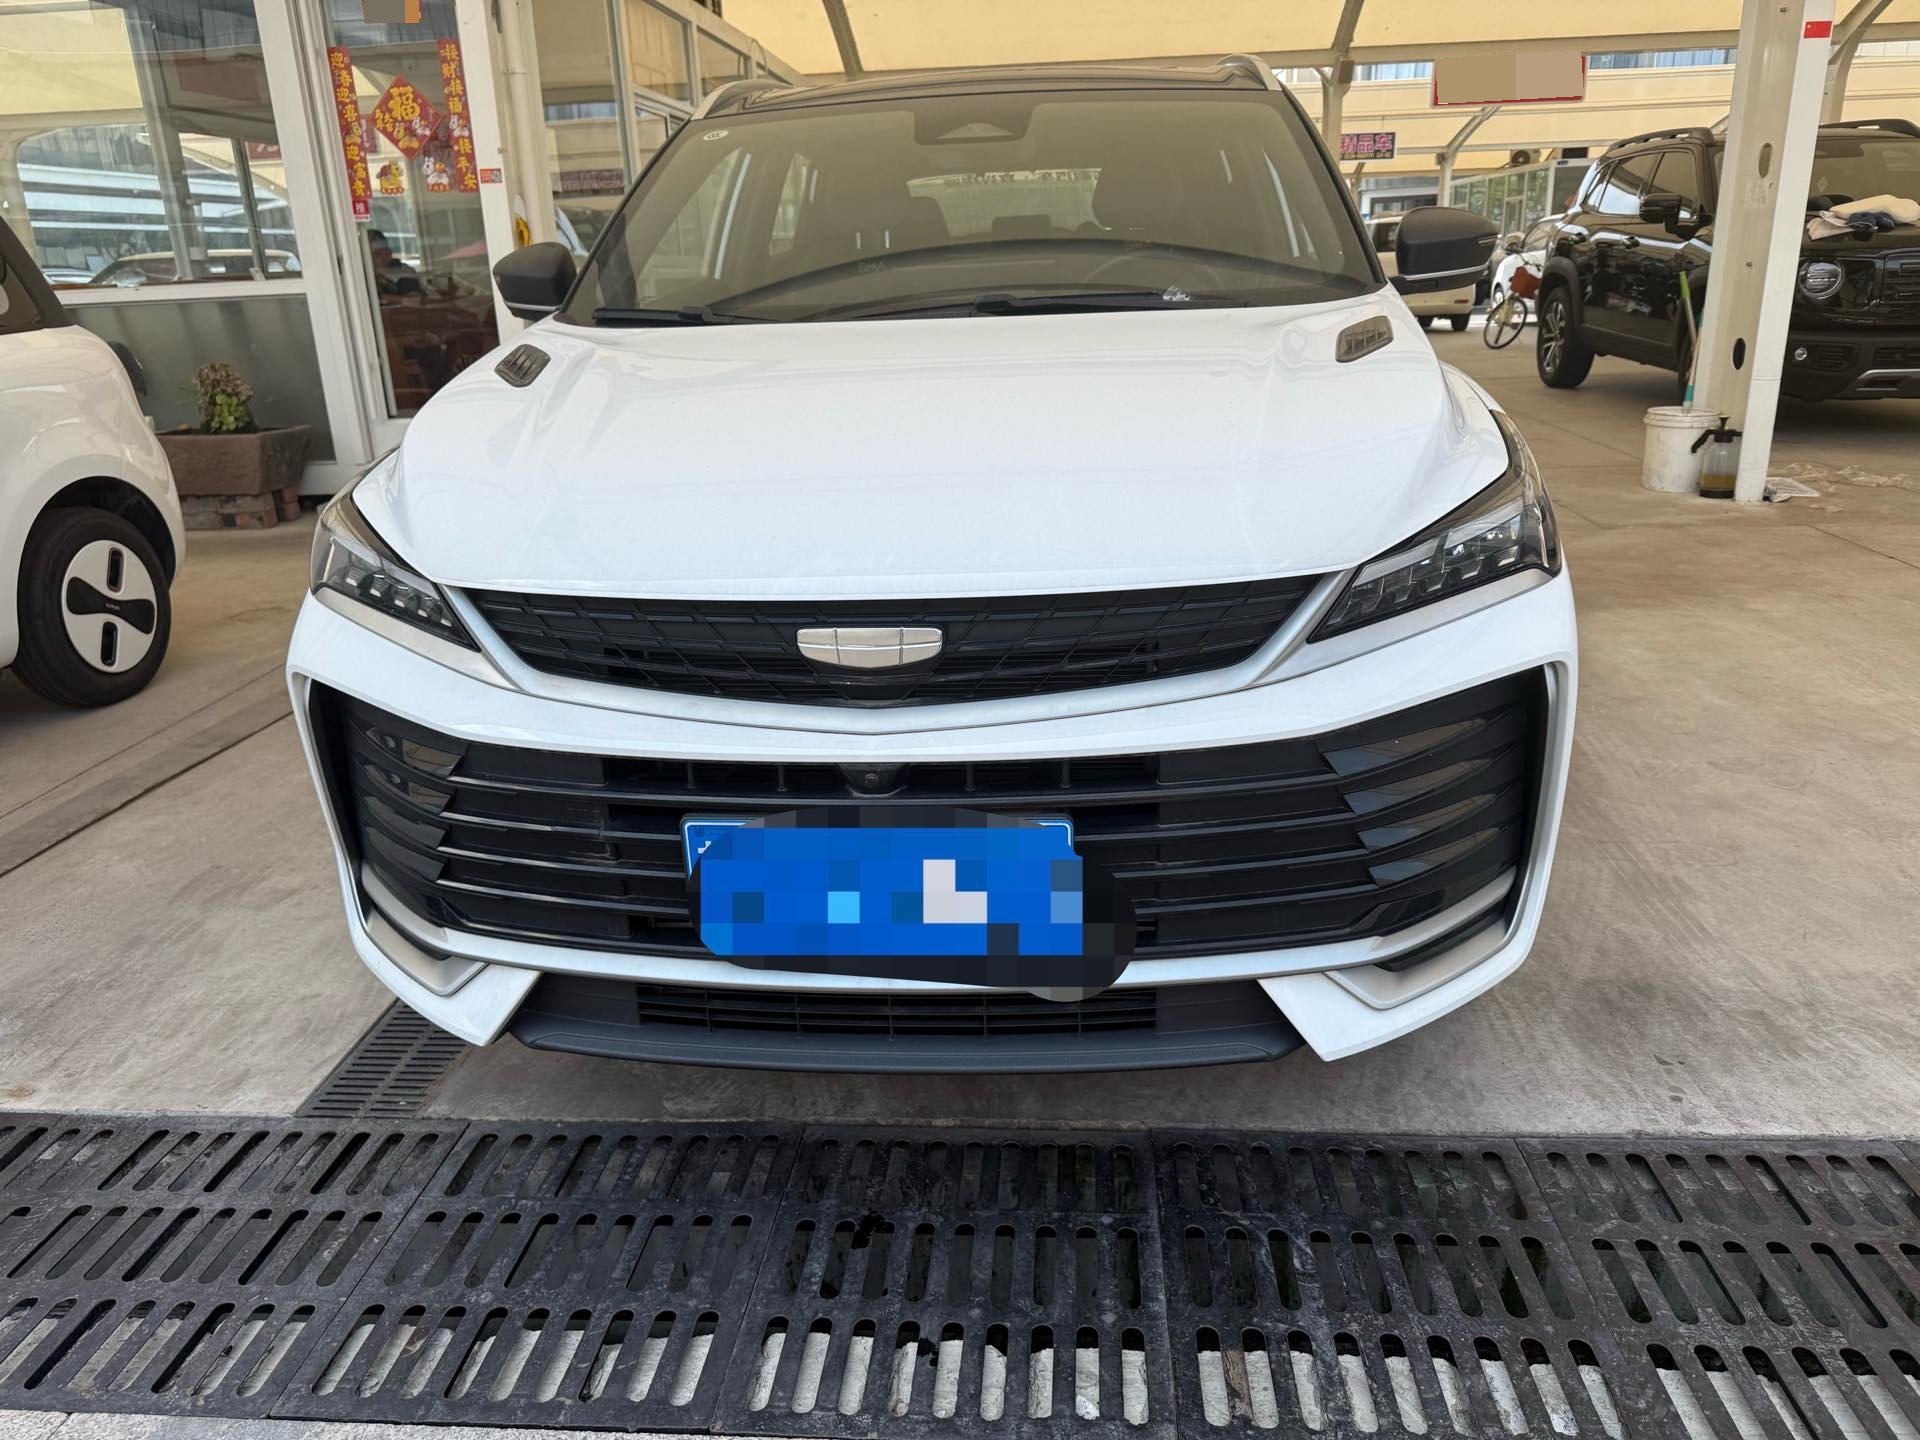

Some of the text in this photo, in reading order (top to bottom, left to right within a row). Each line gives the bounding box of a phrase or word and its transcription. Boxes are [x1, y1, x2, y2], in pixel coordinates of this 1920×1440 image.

[388, 86, 420, 121] 福
[1340, 133, 1393, 153] 精品车
